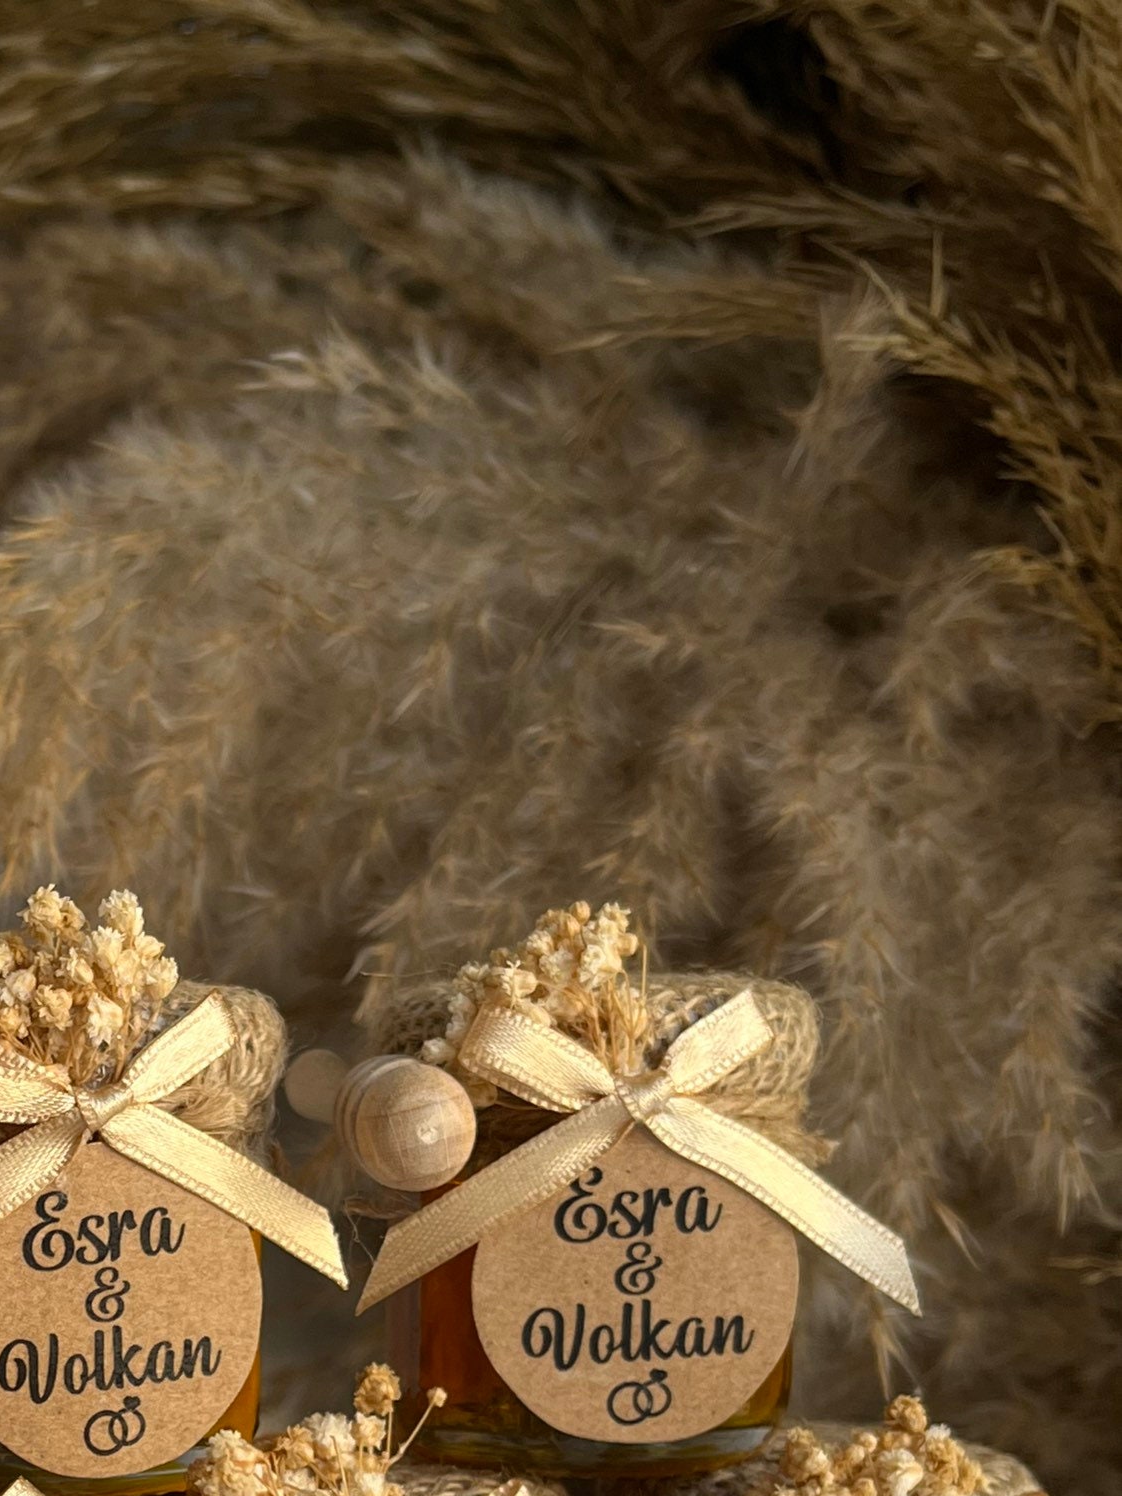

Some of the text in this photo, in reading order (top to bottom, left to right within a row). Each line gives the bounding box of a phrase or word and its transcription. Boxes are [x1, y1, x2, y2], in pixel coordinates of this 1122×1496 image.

[22, 1190, 185, 1271] Esra
[553, 1166, 723, 1243] Esra
[84, 1266, 131, 1322] &
[614, 1241, 663, 1295] &
[521, 1299, 755, 1372] Volkan
